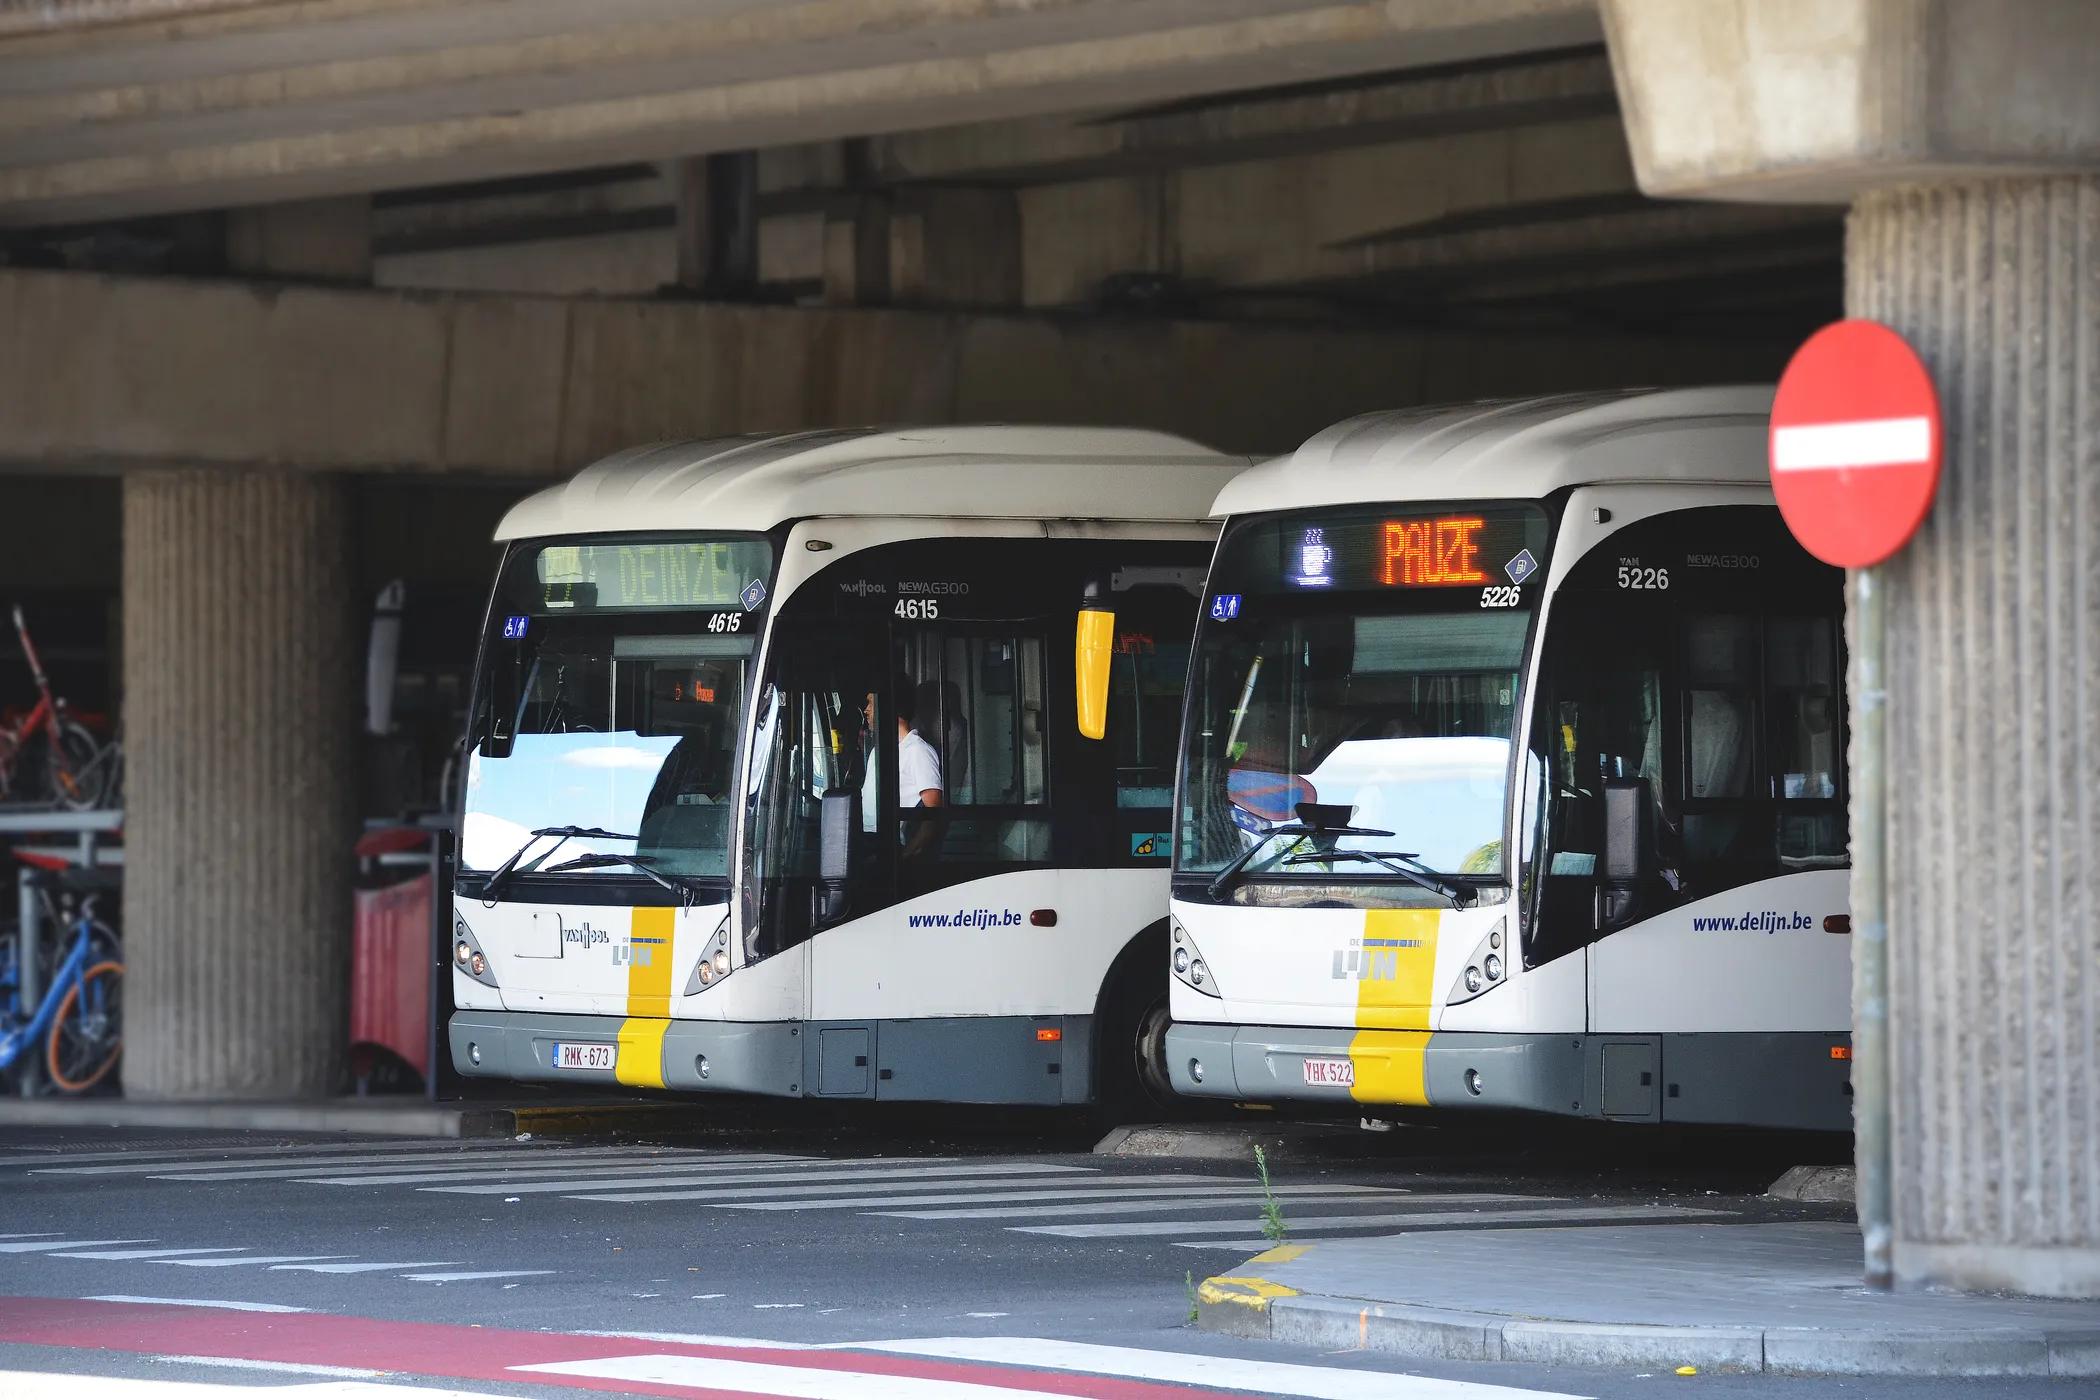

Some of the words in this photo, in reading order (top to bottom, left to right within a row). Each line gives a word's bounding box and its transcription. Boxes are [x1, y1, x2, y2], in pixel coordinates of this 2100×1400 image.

[1385, 520, 1482, 584] PAUZE
[620, 544, 729, 602] DEINZE
[1618, 567, 1669, 590] 5226
[1480, 586, 1521, 608] 5226
[894, 599, 938, 619] 4615
[707, 612, 742, 632] 4615
[909, 908, 1022, 931] www.delijn.be
[1693, 910, 1812, 934] www.delijn.be
